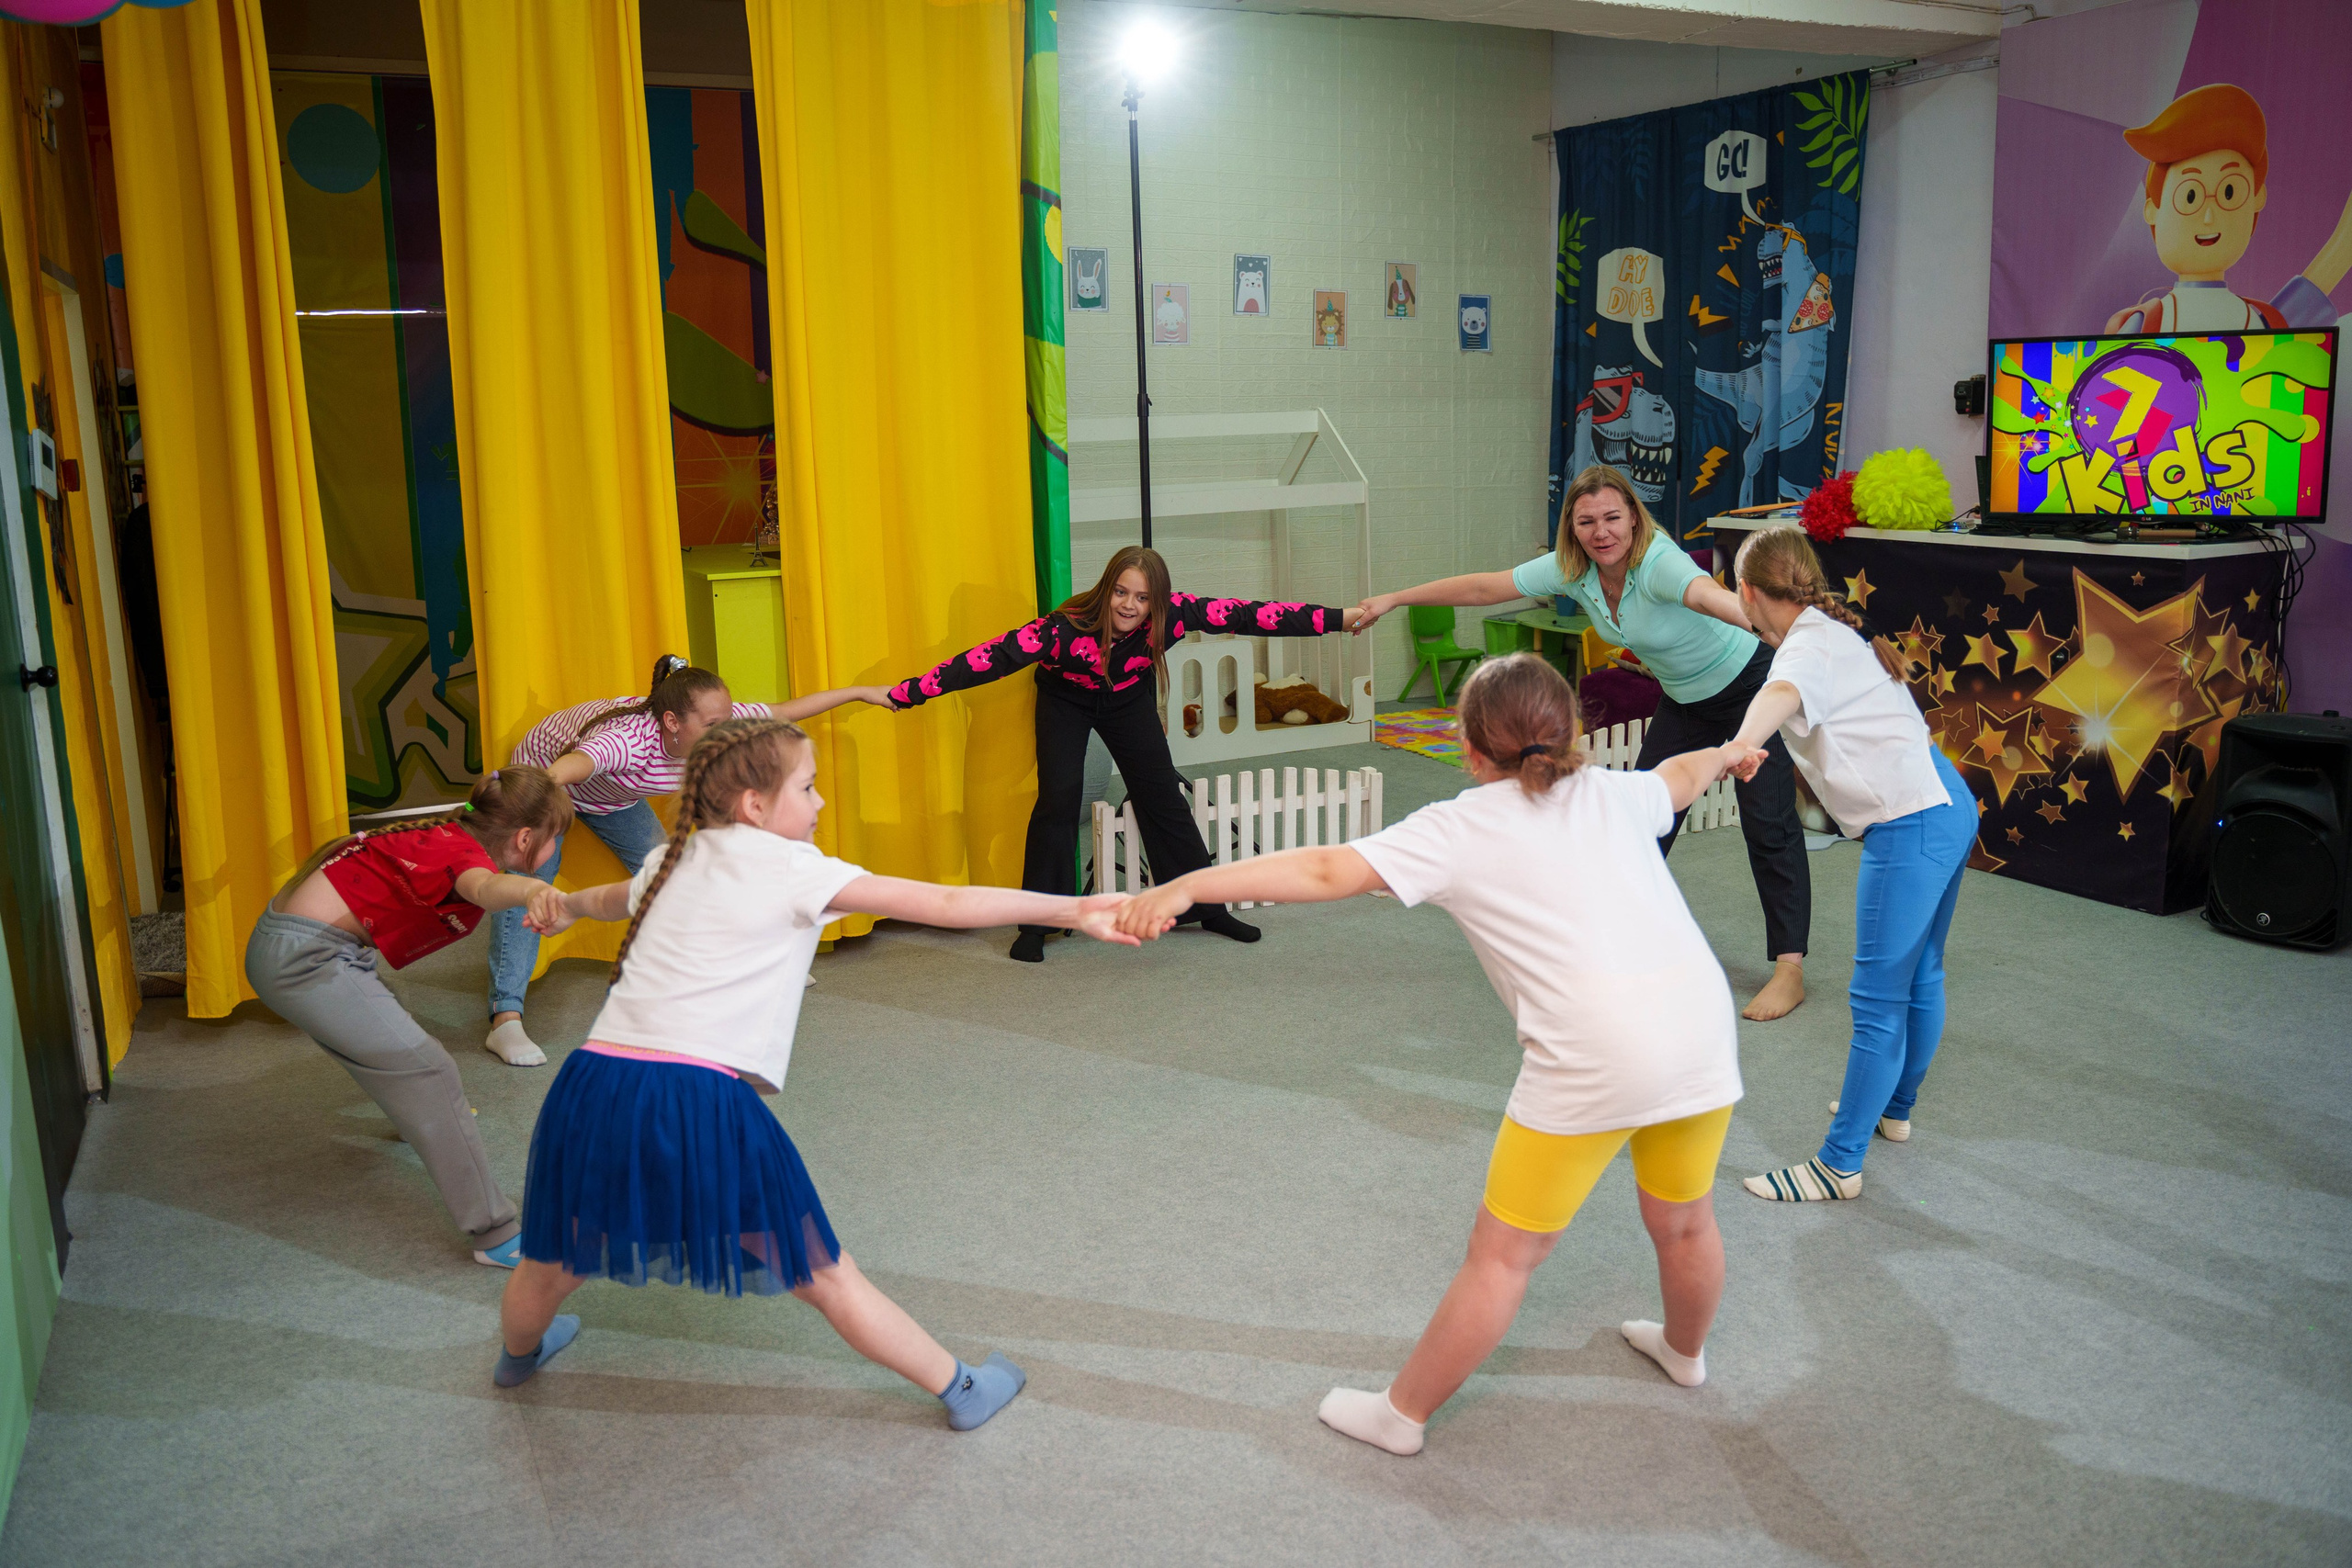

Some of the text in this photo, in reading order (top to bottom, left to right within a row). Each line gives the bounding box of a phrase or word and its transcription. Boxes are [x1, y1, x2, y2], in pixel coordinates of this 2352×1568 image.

[2058, 425, 2256, 514] Kids
[2188, 487, 2256, 513] IN NANI
